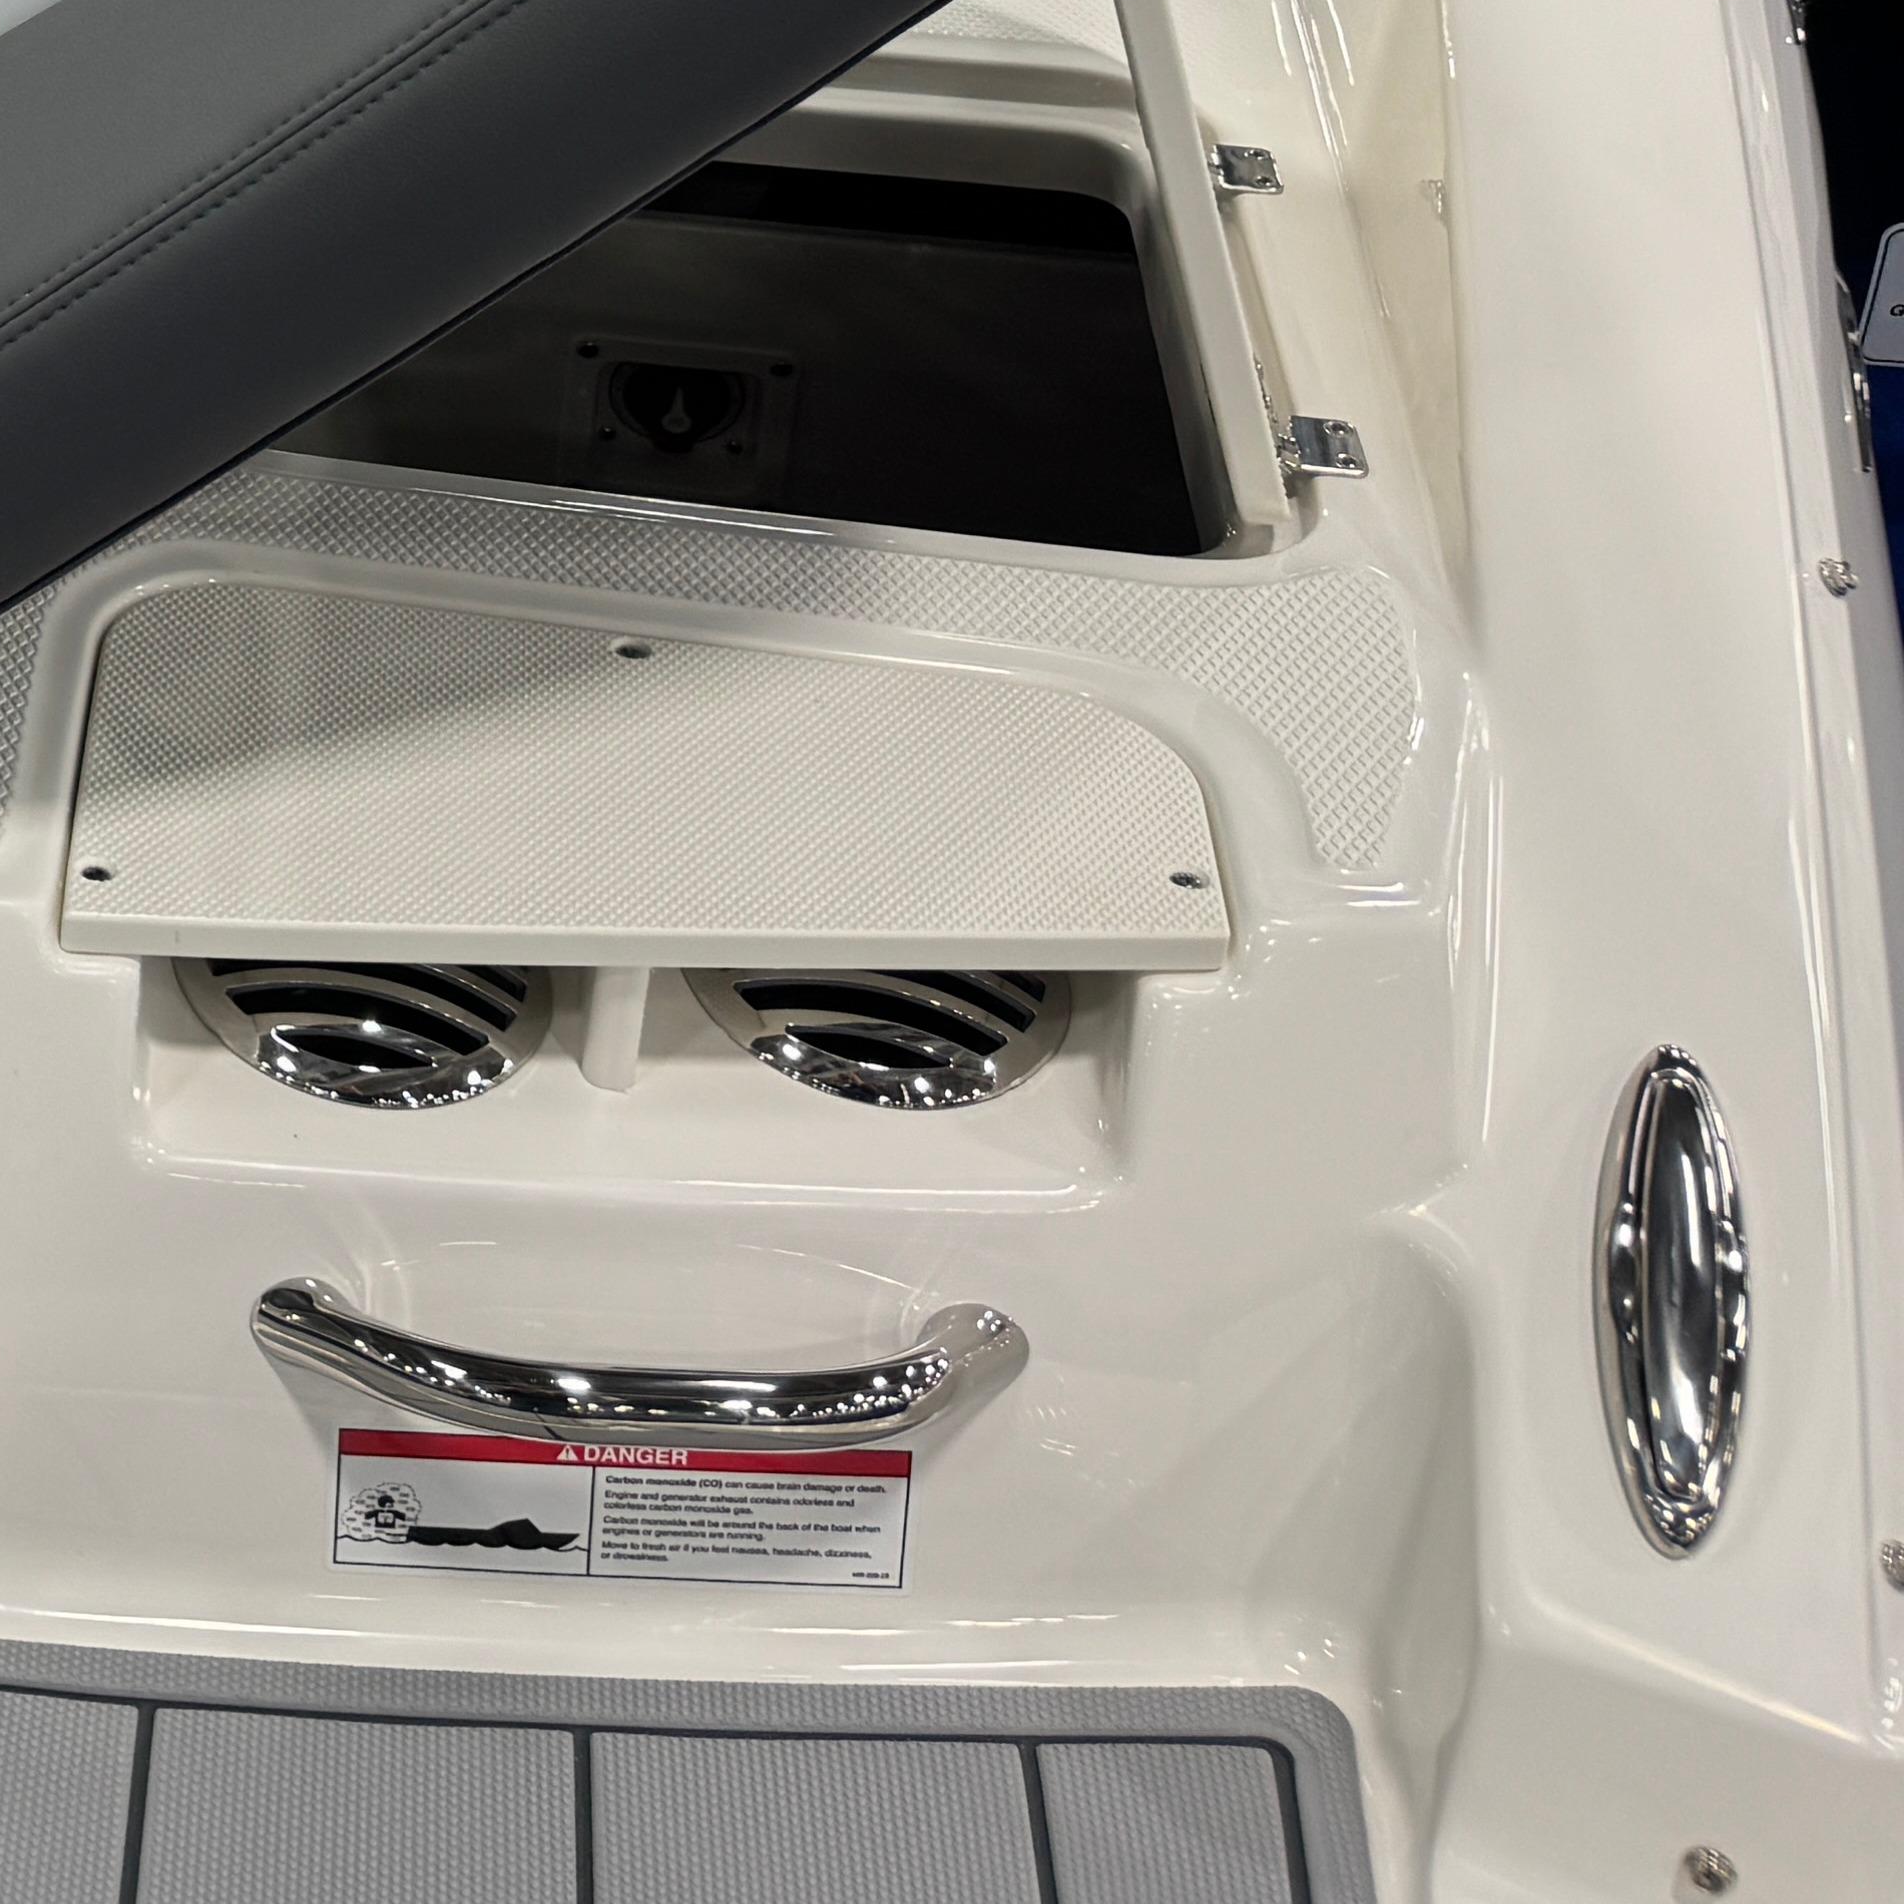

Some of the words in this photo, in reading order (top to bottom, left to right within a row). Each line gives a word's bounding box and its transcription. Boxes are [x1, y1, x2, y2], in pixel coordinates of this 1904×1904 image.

[584, 1444, 688, 1466] DANGER
[605, 1475, 643, 1485] Carbon
[698, 1479, 723, 1489] (CO)
